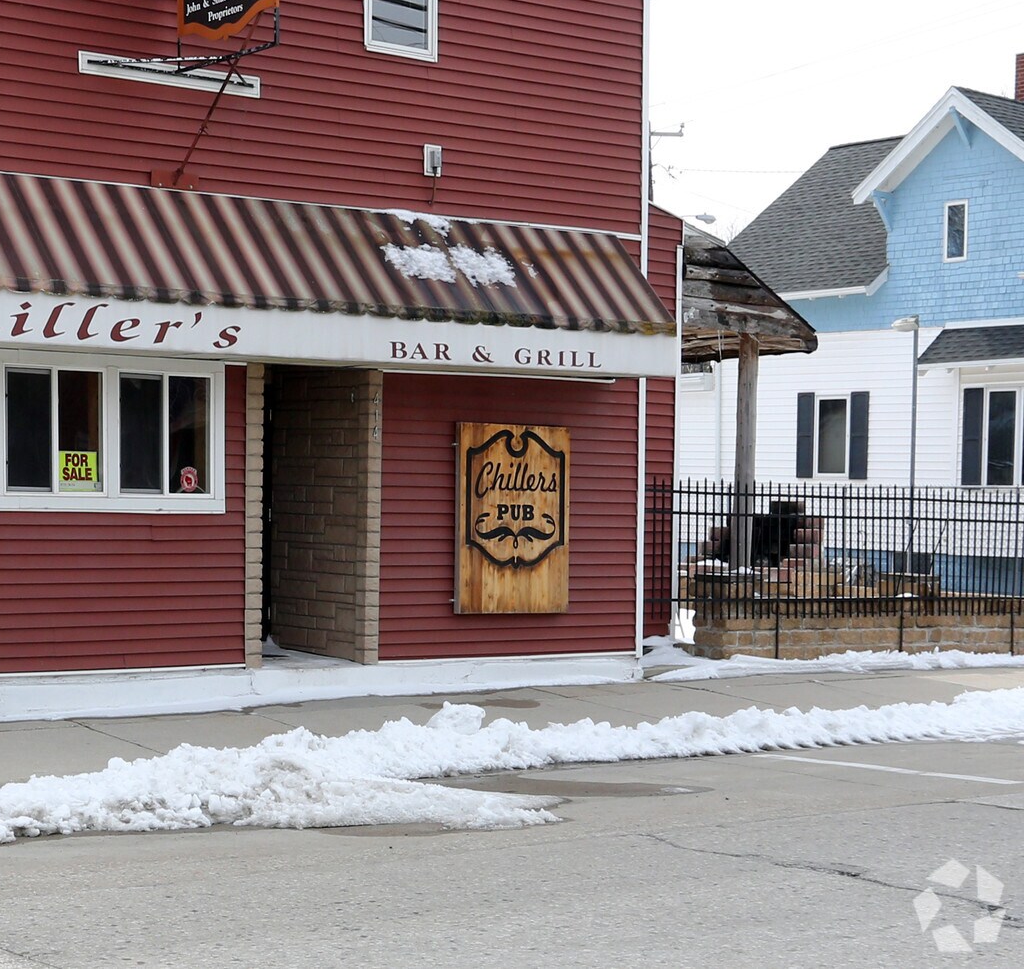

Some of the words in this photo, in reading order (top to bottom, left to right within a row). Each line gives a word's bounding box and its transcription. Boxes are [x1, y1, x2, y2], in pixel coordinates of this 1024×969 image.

[186, 1, 201, 17] John
[208, 4, 244, 22] Proprietors
[390, 341, 452, 361] BAR
[472, 345, 494, 363] &
[514, 347, 602, 368] GRILL
[65, 453, 88, 467] FOR
[62, 467, 93, 481] SALE
[475, 461, 557, 499] Chillers
[497, 504, 535, 521] PUB
